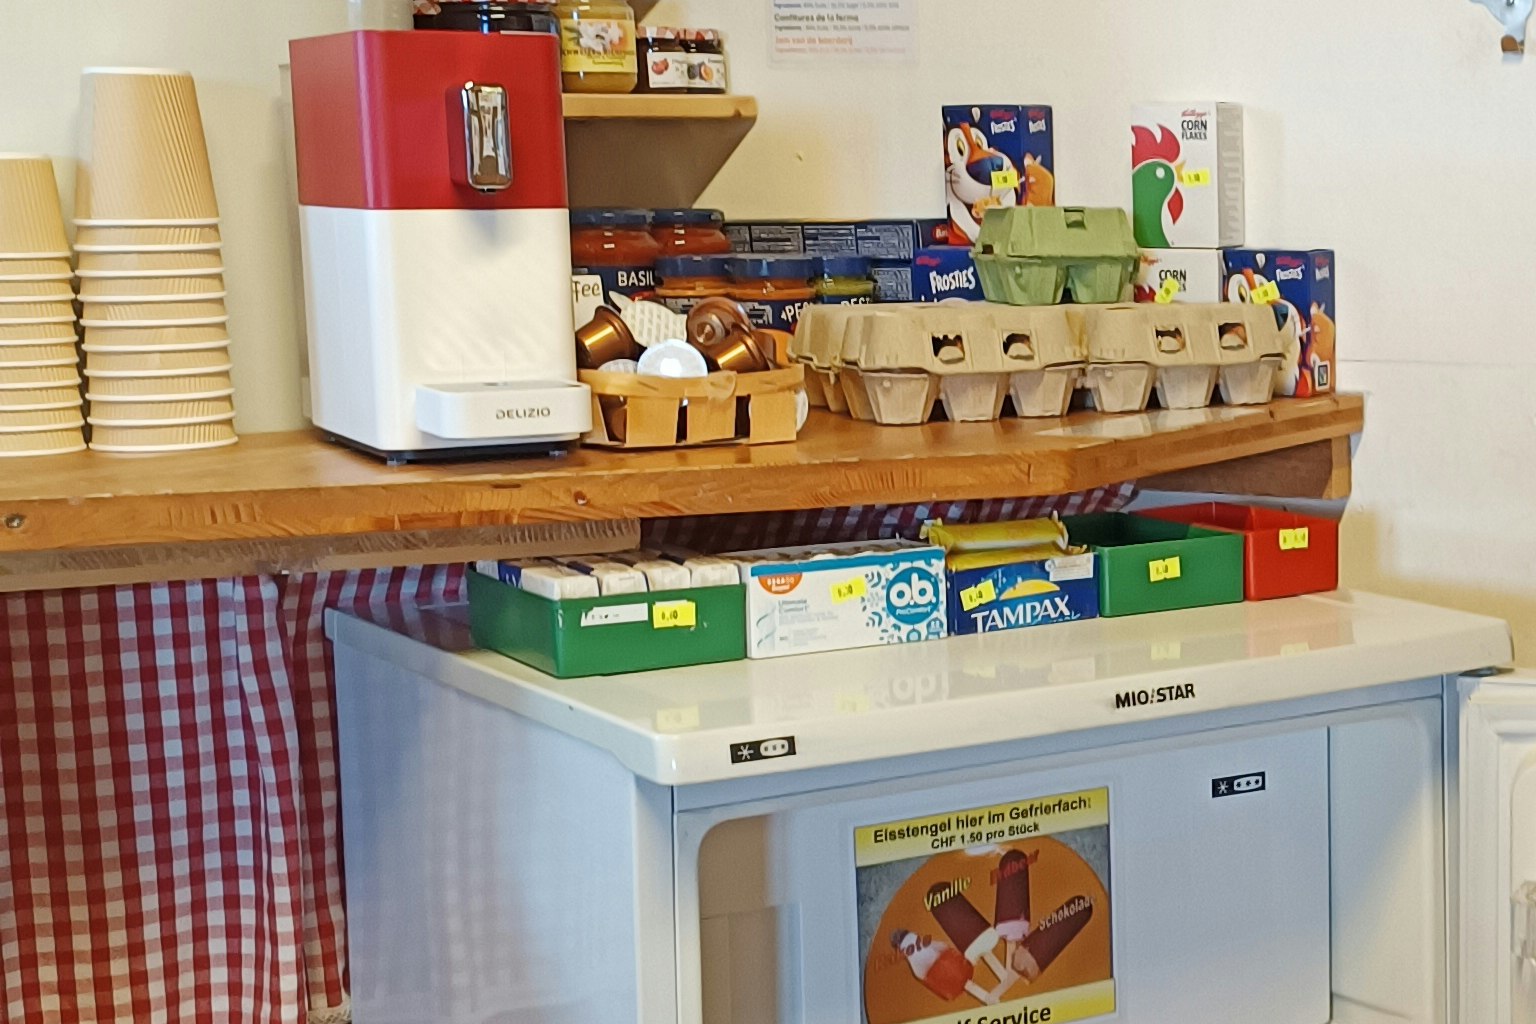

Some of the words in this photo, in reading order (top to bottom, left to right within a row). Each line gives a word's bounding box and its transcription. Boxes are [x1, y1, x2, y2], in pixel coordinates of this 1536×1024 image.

[1181, 119, 1208, 131] CORN
[929, 267, 976, 295] FROSTIES
[1159, 269, 1187, 281] CORN
[495, 407, 551, 420] DELIZIO
[890, 572, 937, 607] o.b.
[970, 594, 1071, 633] TAMPAX
[873, 815, 951, 844] Eisstengel
[956, 813, 983, 831] hier
[988, 811, 1005, 825] im
[930, 834, 957, 850] CHF
[960, 831, 983, 846] 1.50
[986, 829, 1005, 843] pro
[1008, 822, 1040, 837] Stück
[923, 874, 972, 911] Vanille
[1039, 896, 1095, 931] Schokolade
